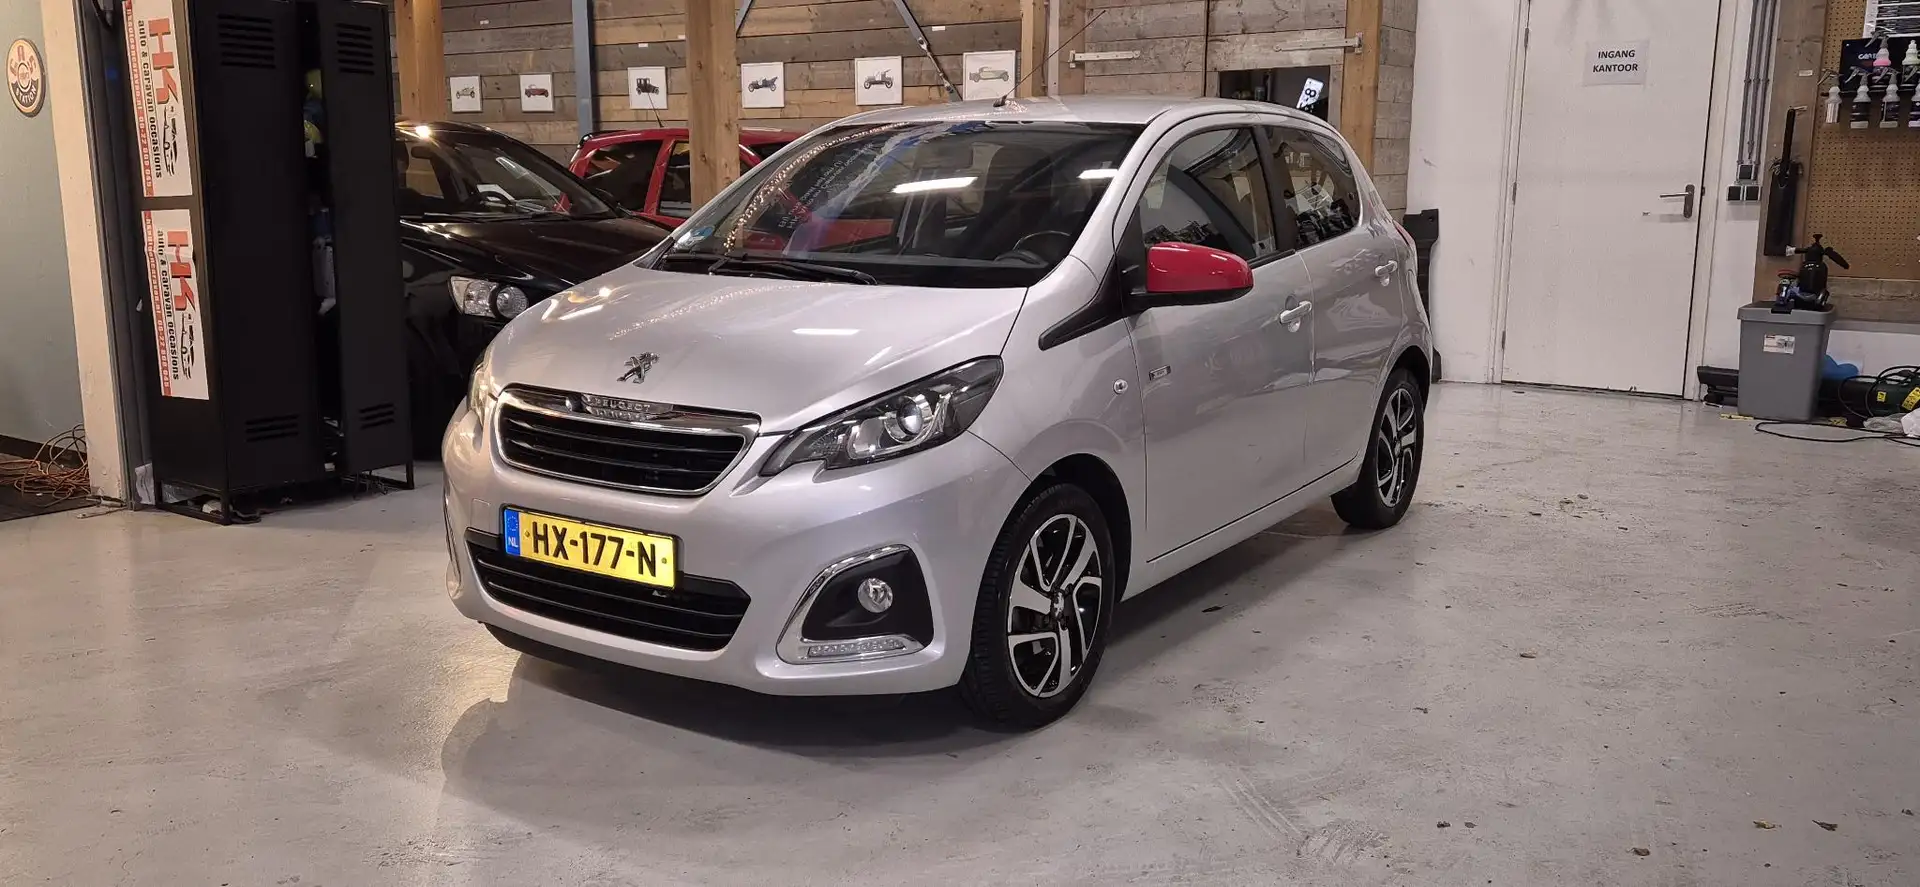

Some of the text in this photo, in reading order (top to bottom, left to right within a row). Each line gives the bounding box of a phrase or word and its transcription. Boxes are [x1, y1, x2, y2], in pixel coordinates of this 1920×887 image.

[148, 18, 179, 104] HK
[1592, 63, 1638, 73] KANTOOR
[1598, 49, 1636, 59] INGANG
[15, 85, 37, 104] STATION
[138, 20, 147, 47] auto
[143, 62, 154, 112] caravan
[149, 116, 162, 178] occasions
[167, 231, 196, 312] HK
[157, 231, 165, 256] auto
[161, 270, 173, 317] caravan
[167, 321, 179, 380] occasions
[595, 398, 651, 412] PEUGEOT
[507, 536, 519, 548] NL
[532, 521, 657, 578] HX-177-N
